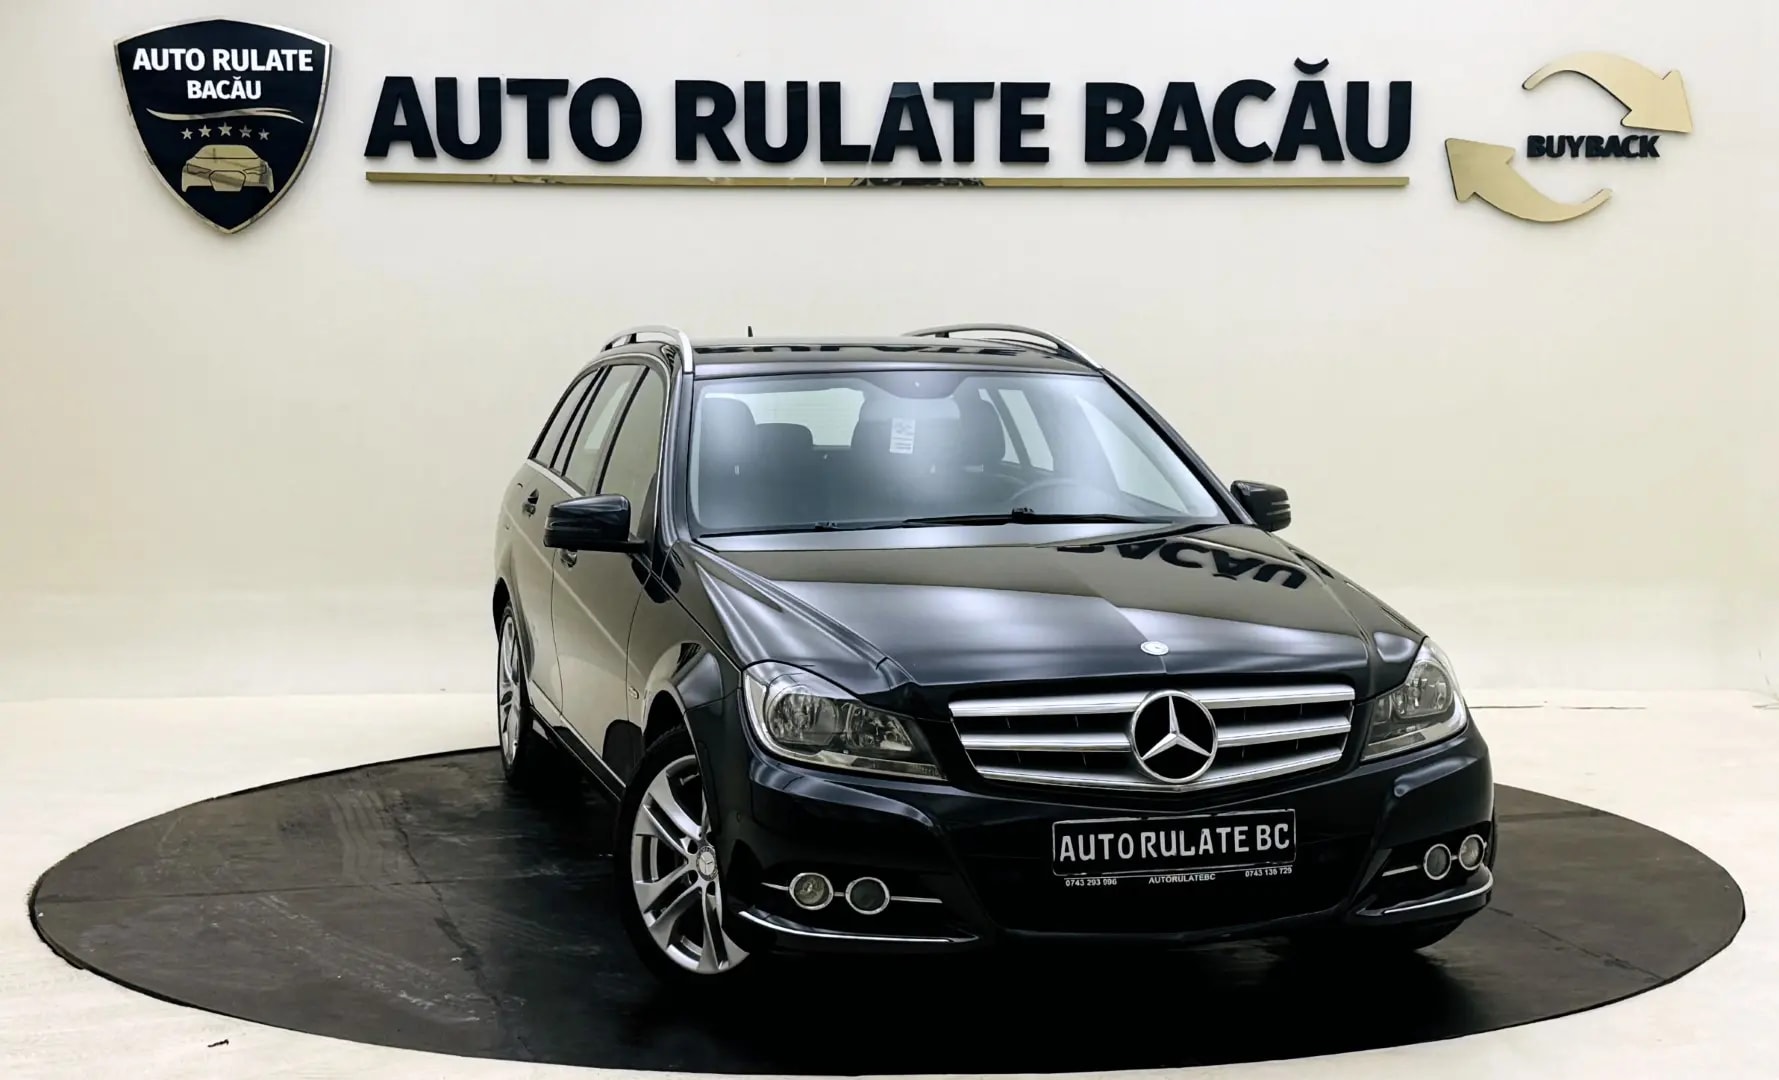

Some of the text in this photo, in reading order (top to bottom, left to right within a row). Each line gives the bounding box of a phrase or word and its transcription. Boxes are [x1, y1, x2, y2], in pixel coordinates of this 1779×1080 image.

[133, 48, 314, 72] AUTO RULATE
[186, 76, 262, 100] BACĂU
[364, 57, 1413, 165] AUTO RULATE BACĂU
[1526, 135, 1661, 158] BUYBACK
[1060, 823, 1290, 862] AUTO RULATE BC
[1065, 879, 1085, 887] 0743
[1148, 873, 1216, 884] AUTORULATEBC
[1245, 869, 1263, 878] 0743
